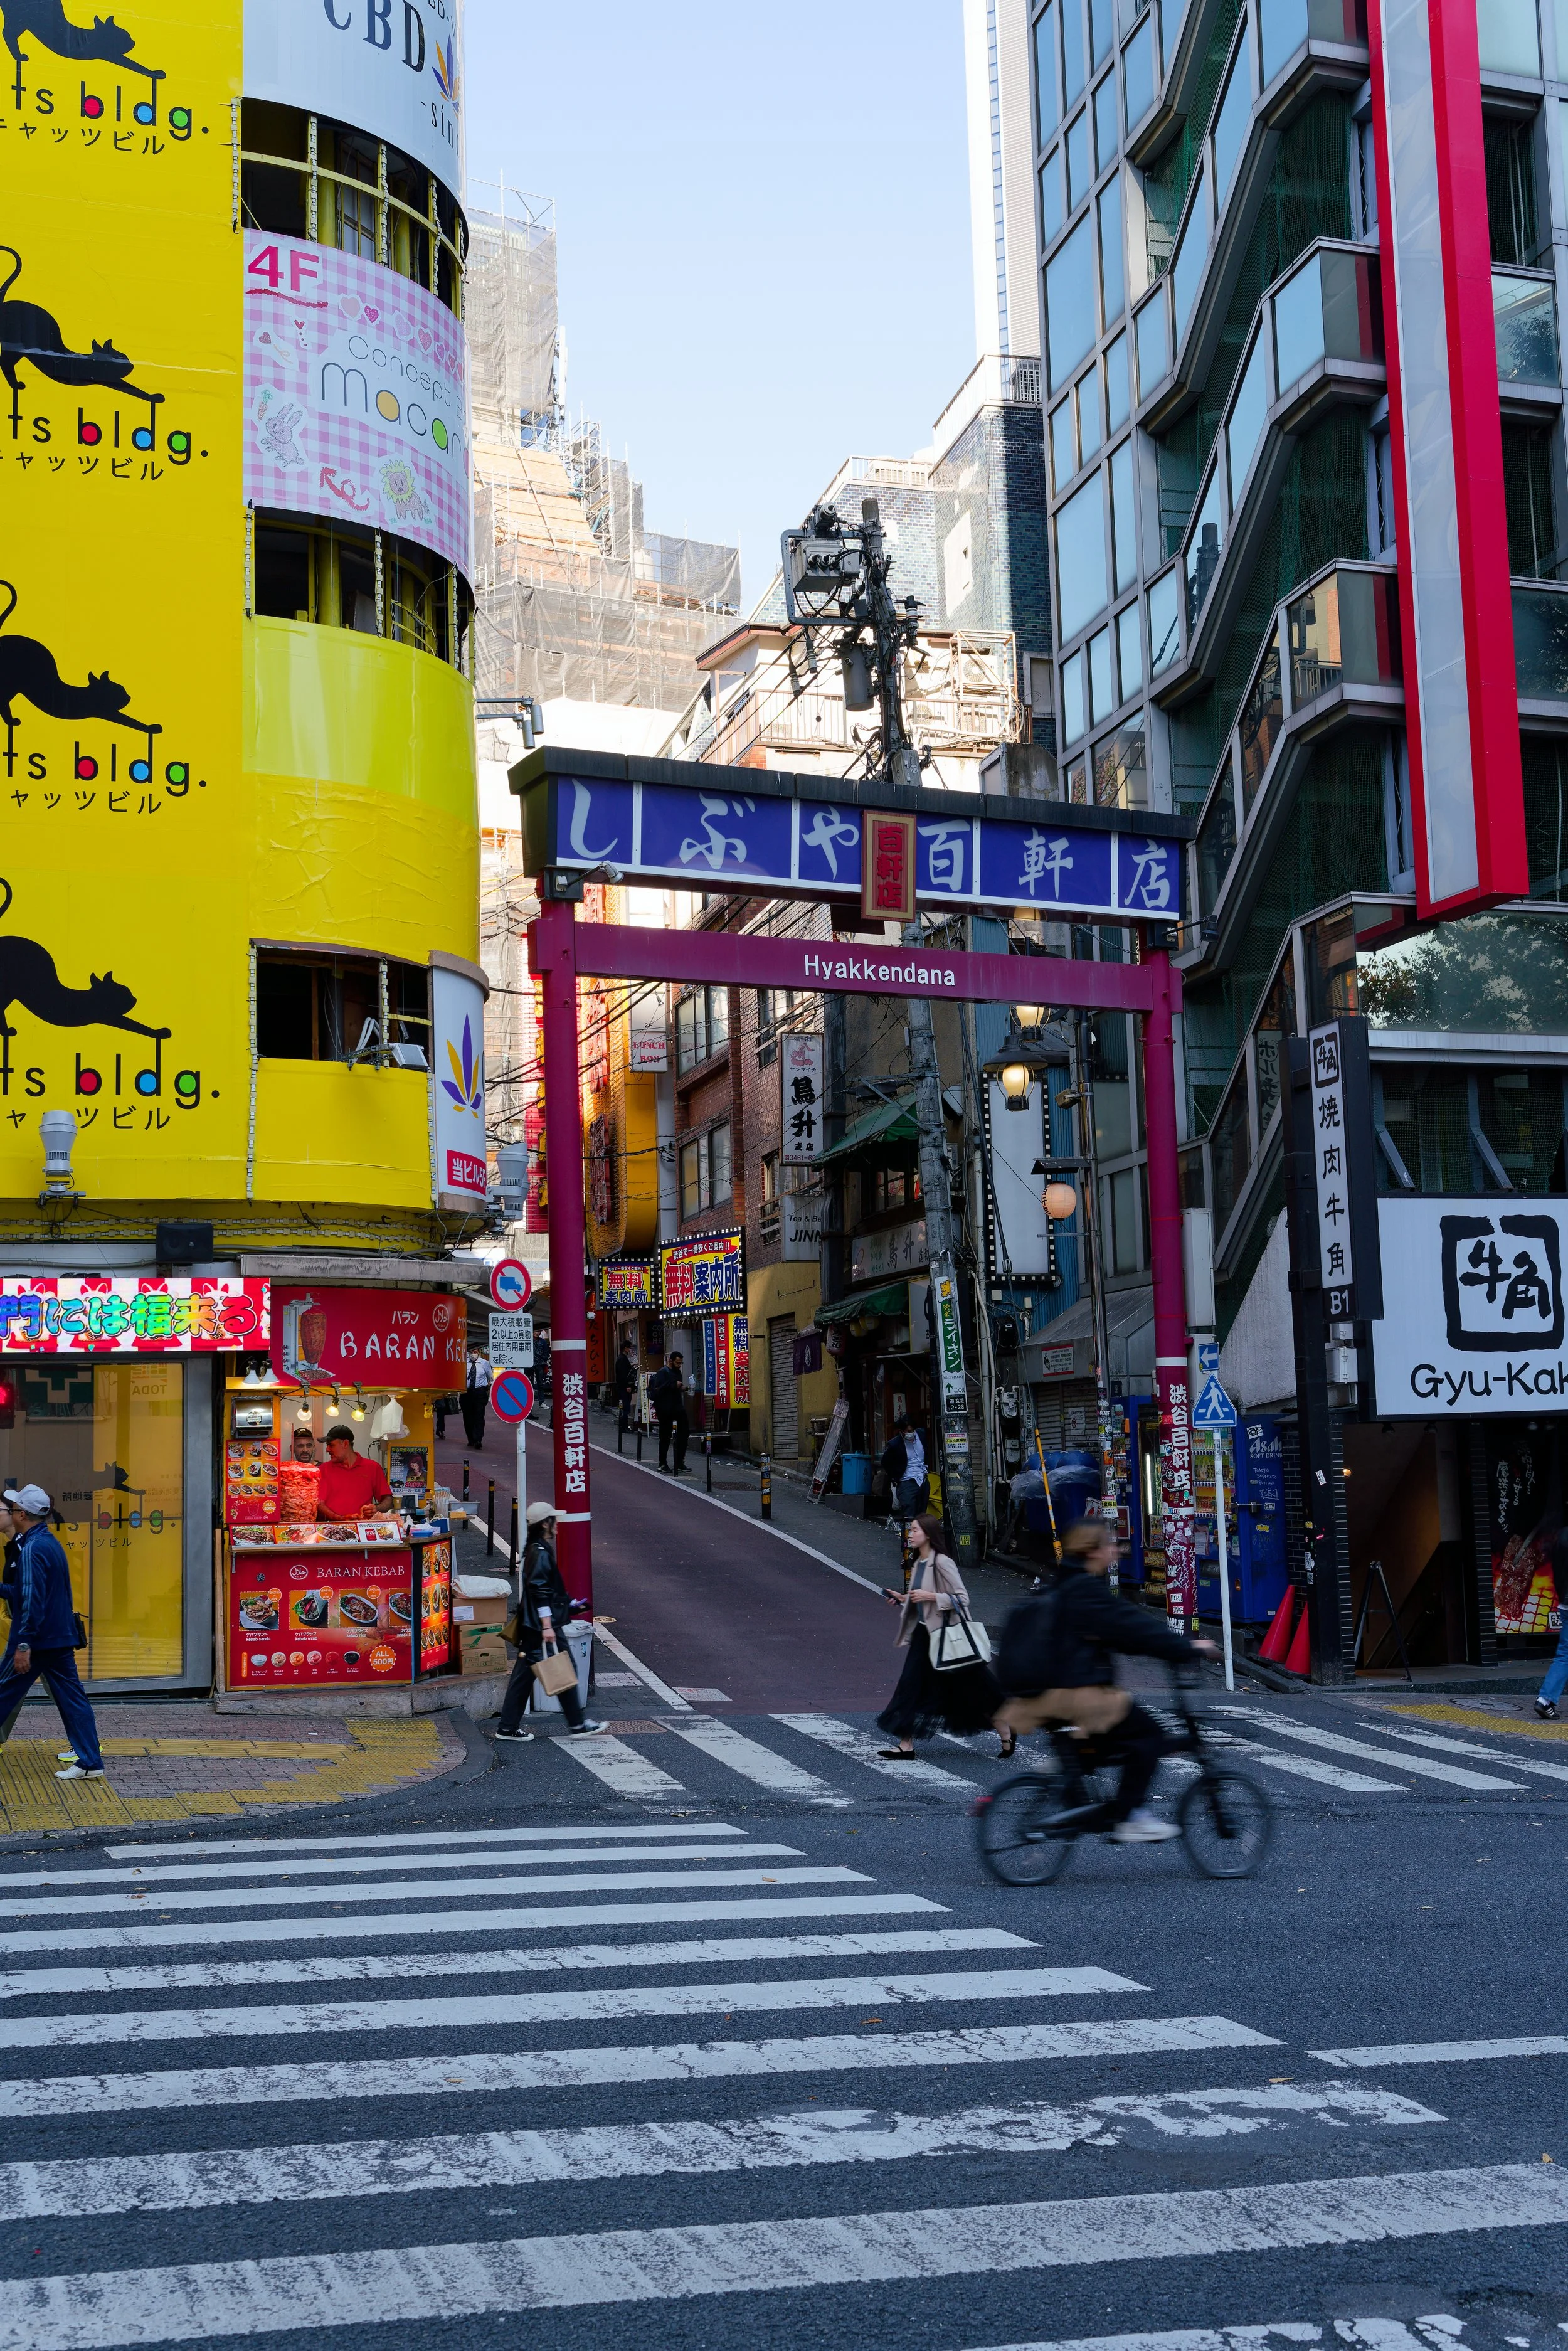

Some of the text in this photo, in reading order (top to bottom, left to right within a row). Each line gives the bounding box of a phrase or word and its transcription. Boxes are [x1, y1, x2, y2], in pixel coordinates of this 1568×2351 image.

[81, 78, 209, 141] bldg.
[0, 119, 165, 155] ャッツビル
[248, 245, 319, 293] 4F
[349, 336, 451, 407] concept
[78, 402, 208, 465] bldg.
[0, 453, 164, 481] ャッツビル
[74, 733, 207, 796] bldg.
[877, 826, 903, 908] 百軒店
[805, 954, 956, 987] Hyakkendana
[75, 1038, 220, 1110] bldg.
[6, 1108, 171, 1130] ャツビル
[795, 1142, 814, 1152] 支店
[1318, 1097, 1346, 1277] 焼肉牛角
[608, 1273, 644, 1290] 無料
[665, 1249, 740, 1310] 無料案内所
[605, 1290, 647, 1303] 案内所
[1330, 1290, 1348, 1315] B1
[491, 1317, 531, 1328] 最大積載量
[492, 1329, 531, 1340] 2t以上の貨物
[340, 1331, 435, 1360] BARAN
[492, 1342, 531, 1352] 居住者用車両
[492, 1354, 514, 1364] を除く
[563, 1373, 586, 1492] 渋谷百軒店
[1169, 1384, 1191, 1490] 渋谷百軒店
[98, 1503, 176, 1534] bldg.
[317, 1566, 405, 1578] BARAN KEBAB
